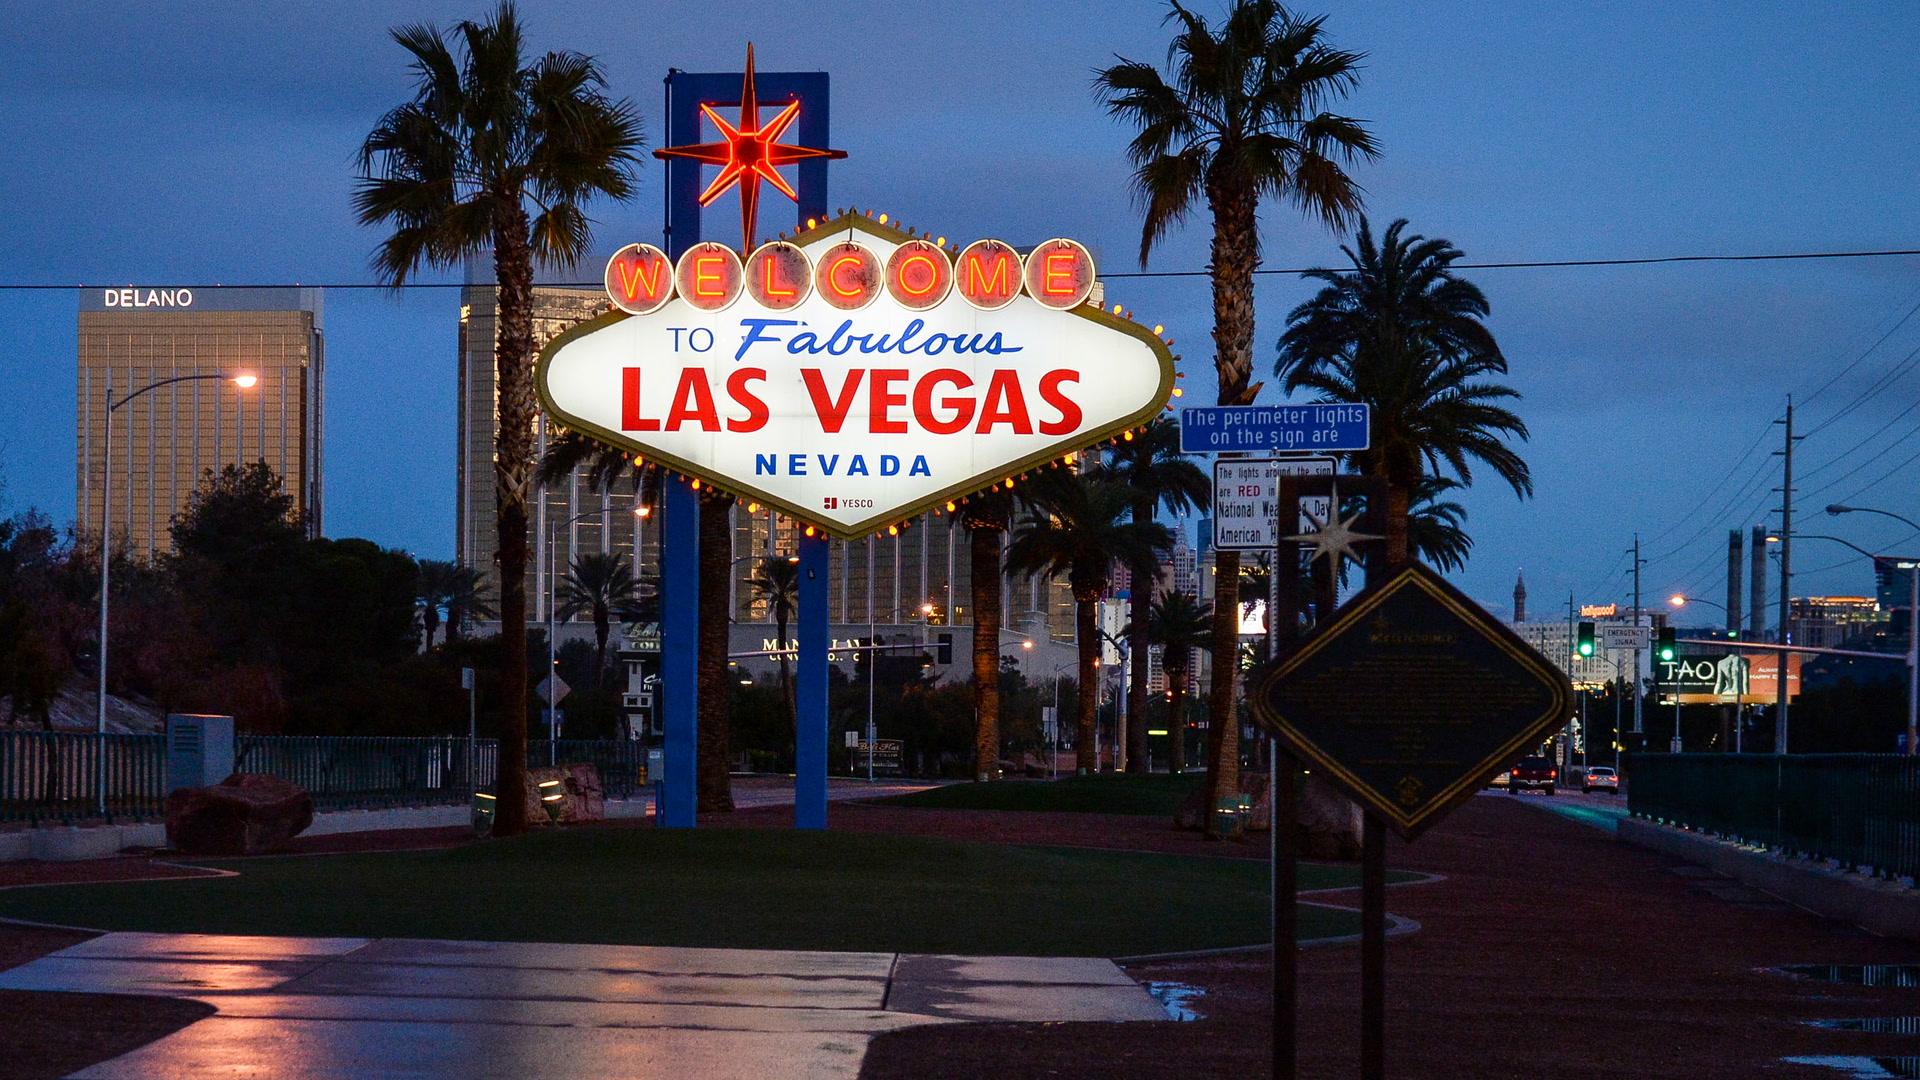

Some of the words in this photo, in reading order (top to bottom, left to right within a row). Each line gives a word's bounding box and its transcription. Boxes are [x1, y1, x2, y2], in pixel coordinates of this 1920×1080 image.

[615, 250, 1080, 303] WELCOME
[104, 288, 193, 308] DELANO
[667, 326, 714, 353] TO
[734, 317, 1024, 361] Fabulous
[620, 366, 770, 433] LAS
[800, 366, 1082, 436] VEGAS
[1186, 409, 1216, 427] The
[1223, 408, 1308, 430] perimeter
[1315, 405, 1364, 430] lights
[1210, 431, 1230, 445] on
[1237, 428, 1264, 444] the
[1270, 427, 1304, 448] sign
[1312, 429, 1339, 443] are
[755, 453, 932, 477] NEVADA
[1219, 467, 1233, 479] The
[1238, 467, 1260, 481] lights
[1219, 487, 1231, 498] are
[1238, 485, 1261, 497] RED
[842, 498, 874, 508] YESCO
[1218, 500, 1255, 518] National
[1220, 526, 1261, 543] American
[1607, 629, 1644, 637] EMERGENCY
[1659, 660, 1715, 680] TAO
